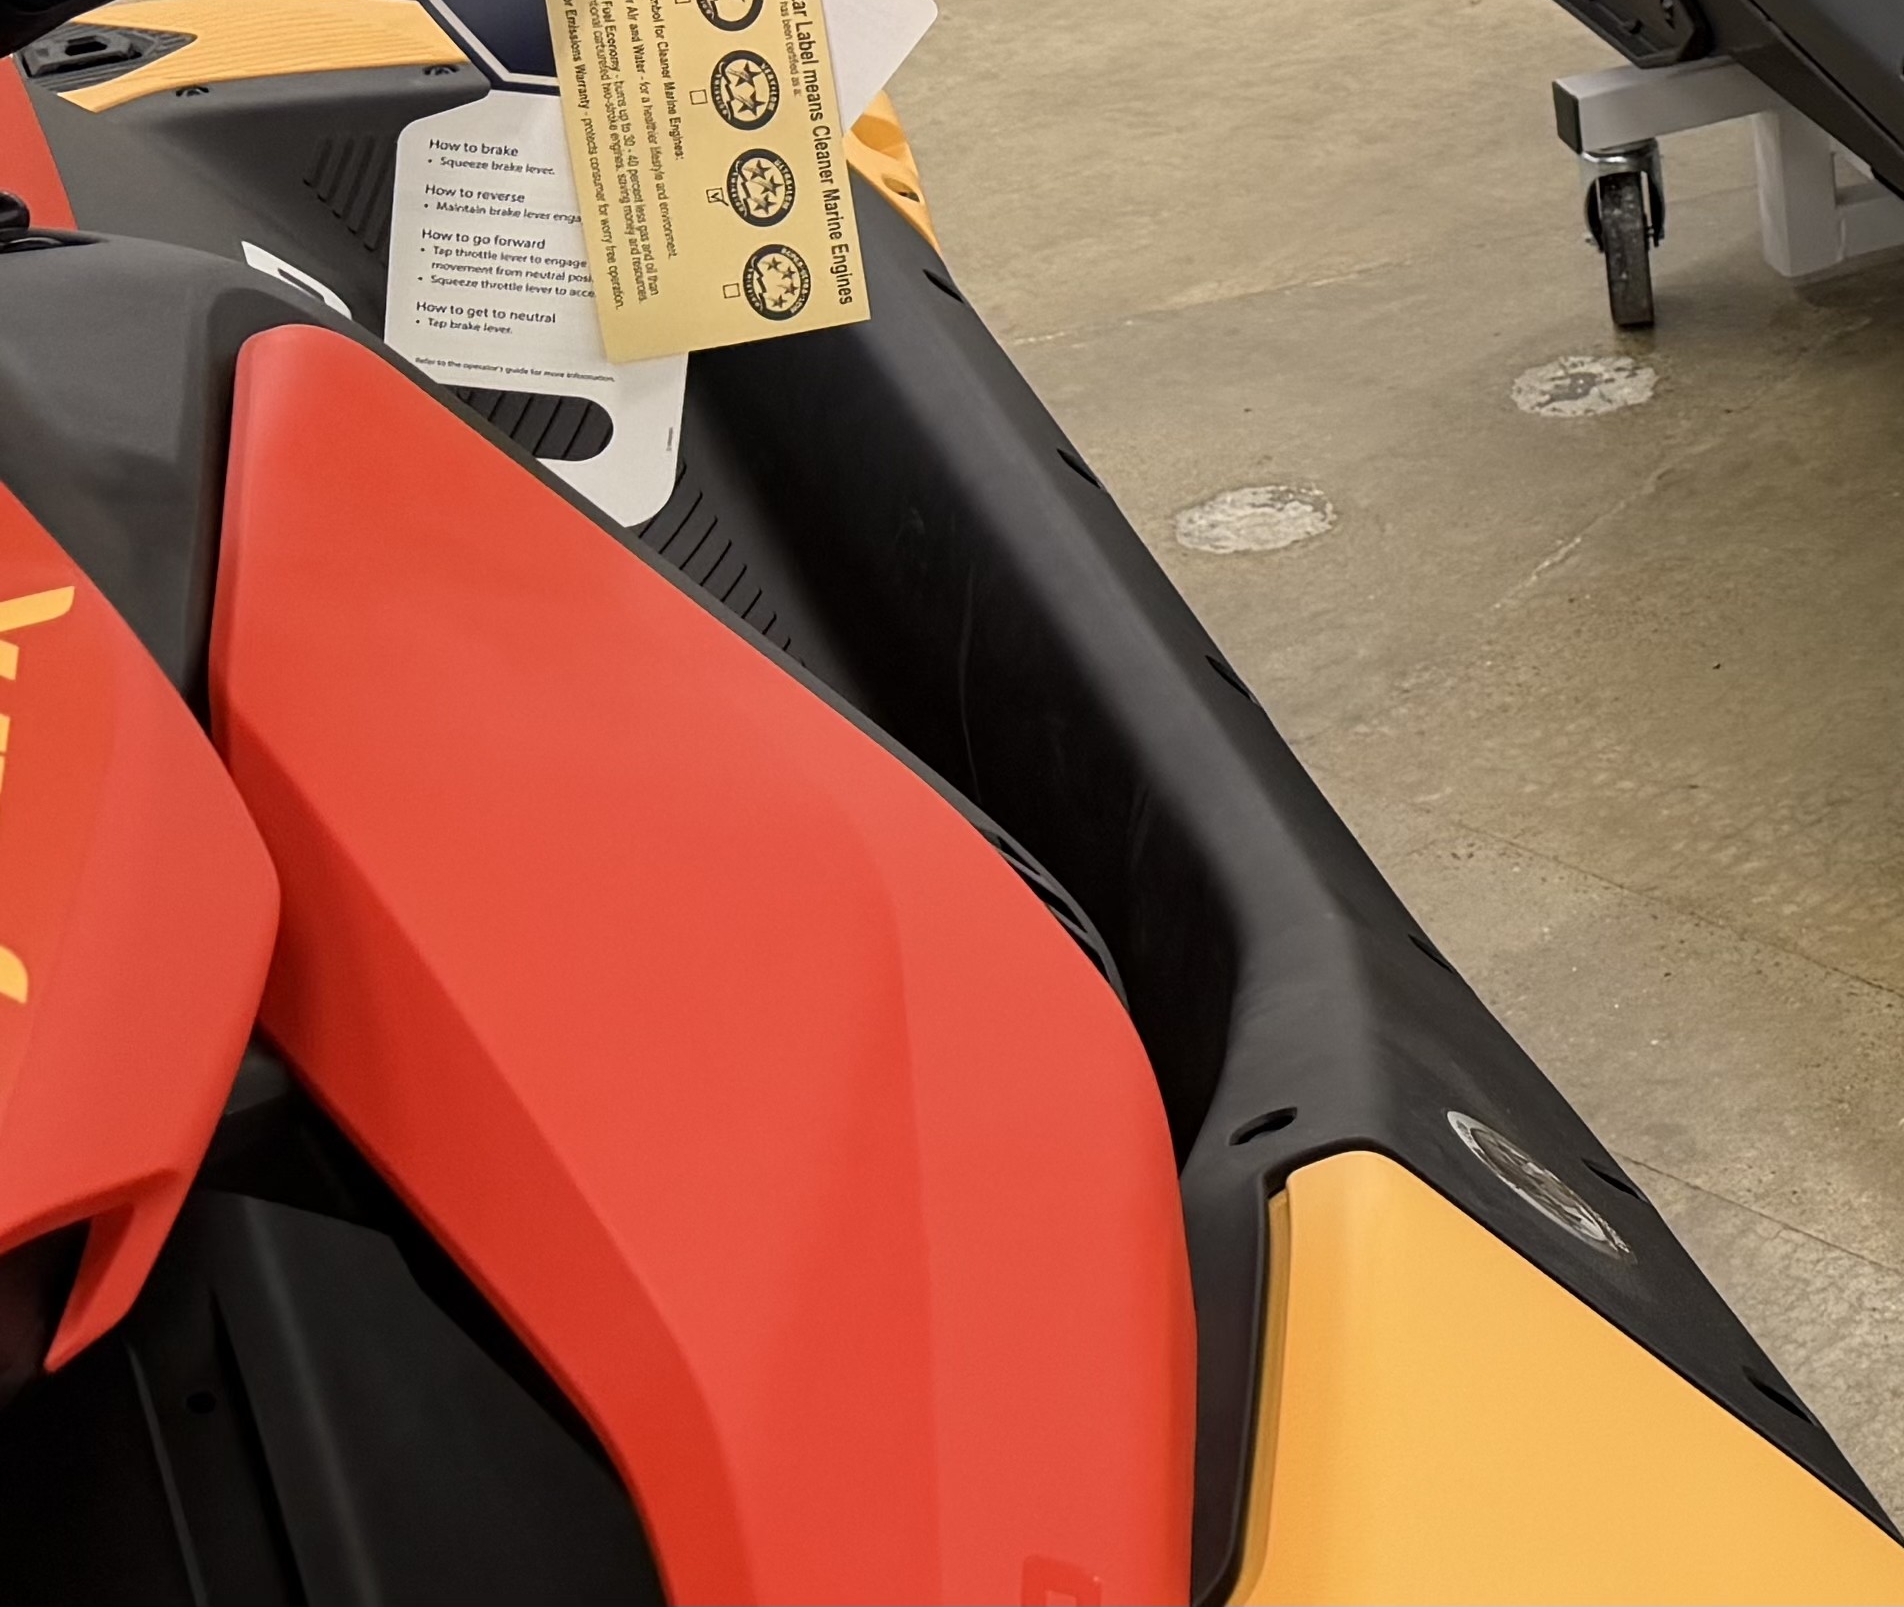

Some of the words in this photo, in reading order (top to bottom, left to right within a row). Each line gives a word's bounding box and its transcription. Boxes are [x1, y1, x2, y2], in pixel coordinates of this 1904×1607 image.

[653, 24, 665, 39] for
[795, 20, 818, 64] Label
[656, 41, 671, 78] Cleaner
[663, 81, 677, 114] Marine
[802, 69, 823, 121] means
[429, 138, 460, 152] How
[464, 142, 478, 154] to
[481, 143, 519, 157] brake
[668, 116, 684, 160] Engines:
[812, 125, 833, 183] Cleaner
[440, 157, 489, 170] Squeeze
[491, 161, 523, 174] brake
[525, 163, 556, 176] lever.
[425, 183, 457, 197] How
[459, 187, 474, 199] to
[477, 191, 526, 204] reverse
[436, 201, 486, 215] Maintain
[489, 206, 521, 219] brake
[523, 208, 551, 220] lever
[822, 188, 843, 239] Marine
[421, 228, 453, 242] How
[456, 232, 470, 243] to
[473, 235, 491, 246] go
[494, 234, 546, 250] forward
[433, 245, 453, 257] Tap
[455, 247, 498, 261] throttle
[500, 251, 528, 263] lever
[530, 254, 542, 264] to
[544, 258, 588, 269] engage
[431, 261, 494, 275] movement
[496, 265, 523, 278] from
[525, 269, 566, 281] neutral
[829, 243, 852, 304] Engines
[430, 274, 479, 288] Squeeze
[480, 279, 523, 293] throttle
[525, 282, 552, 294] lever
[555, 286, 567, 296] to
[416, 301, 447, 313] How
[450, 305, 464, 316] to
[467, 306, 488, 319] get
[492, 309, 506, 320] to
[509, 311, 556, 324] neutral
[428, 318, 447, 330] Tap
[449, 319, 480, 332] brake
[483, 324, 513, 335] lever.
